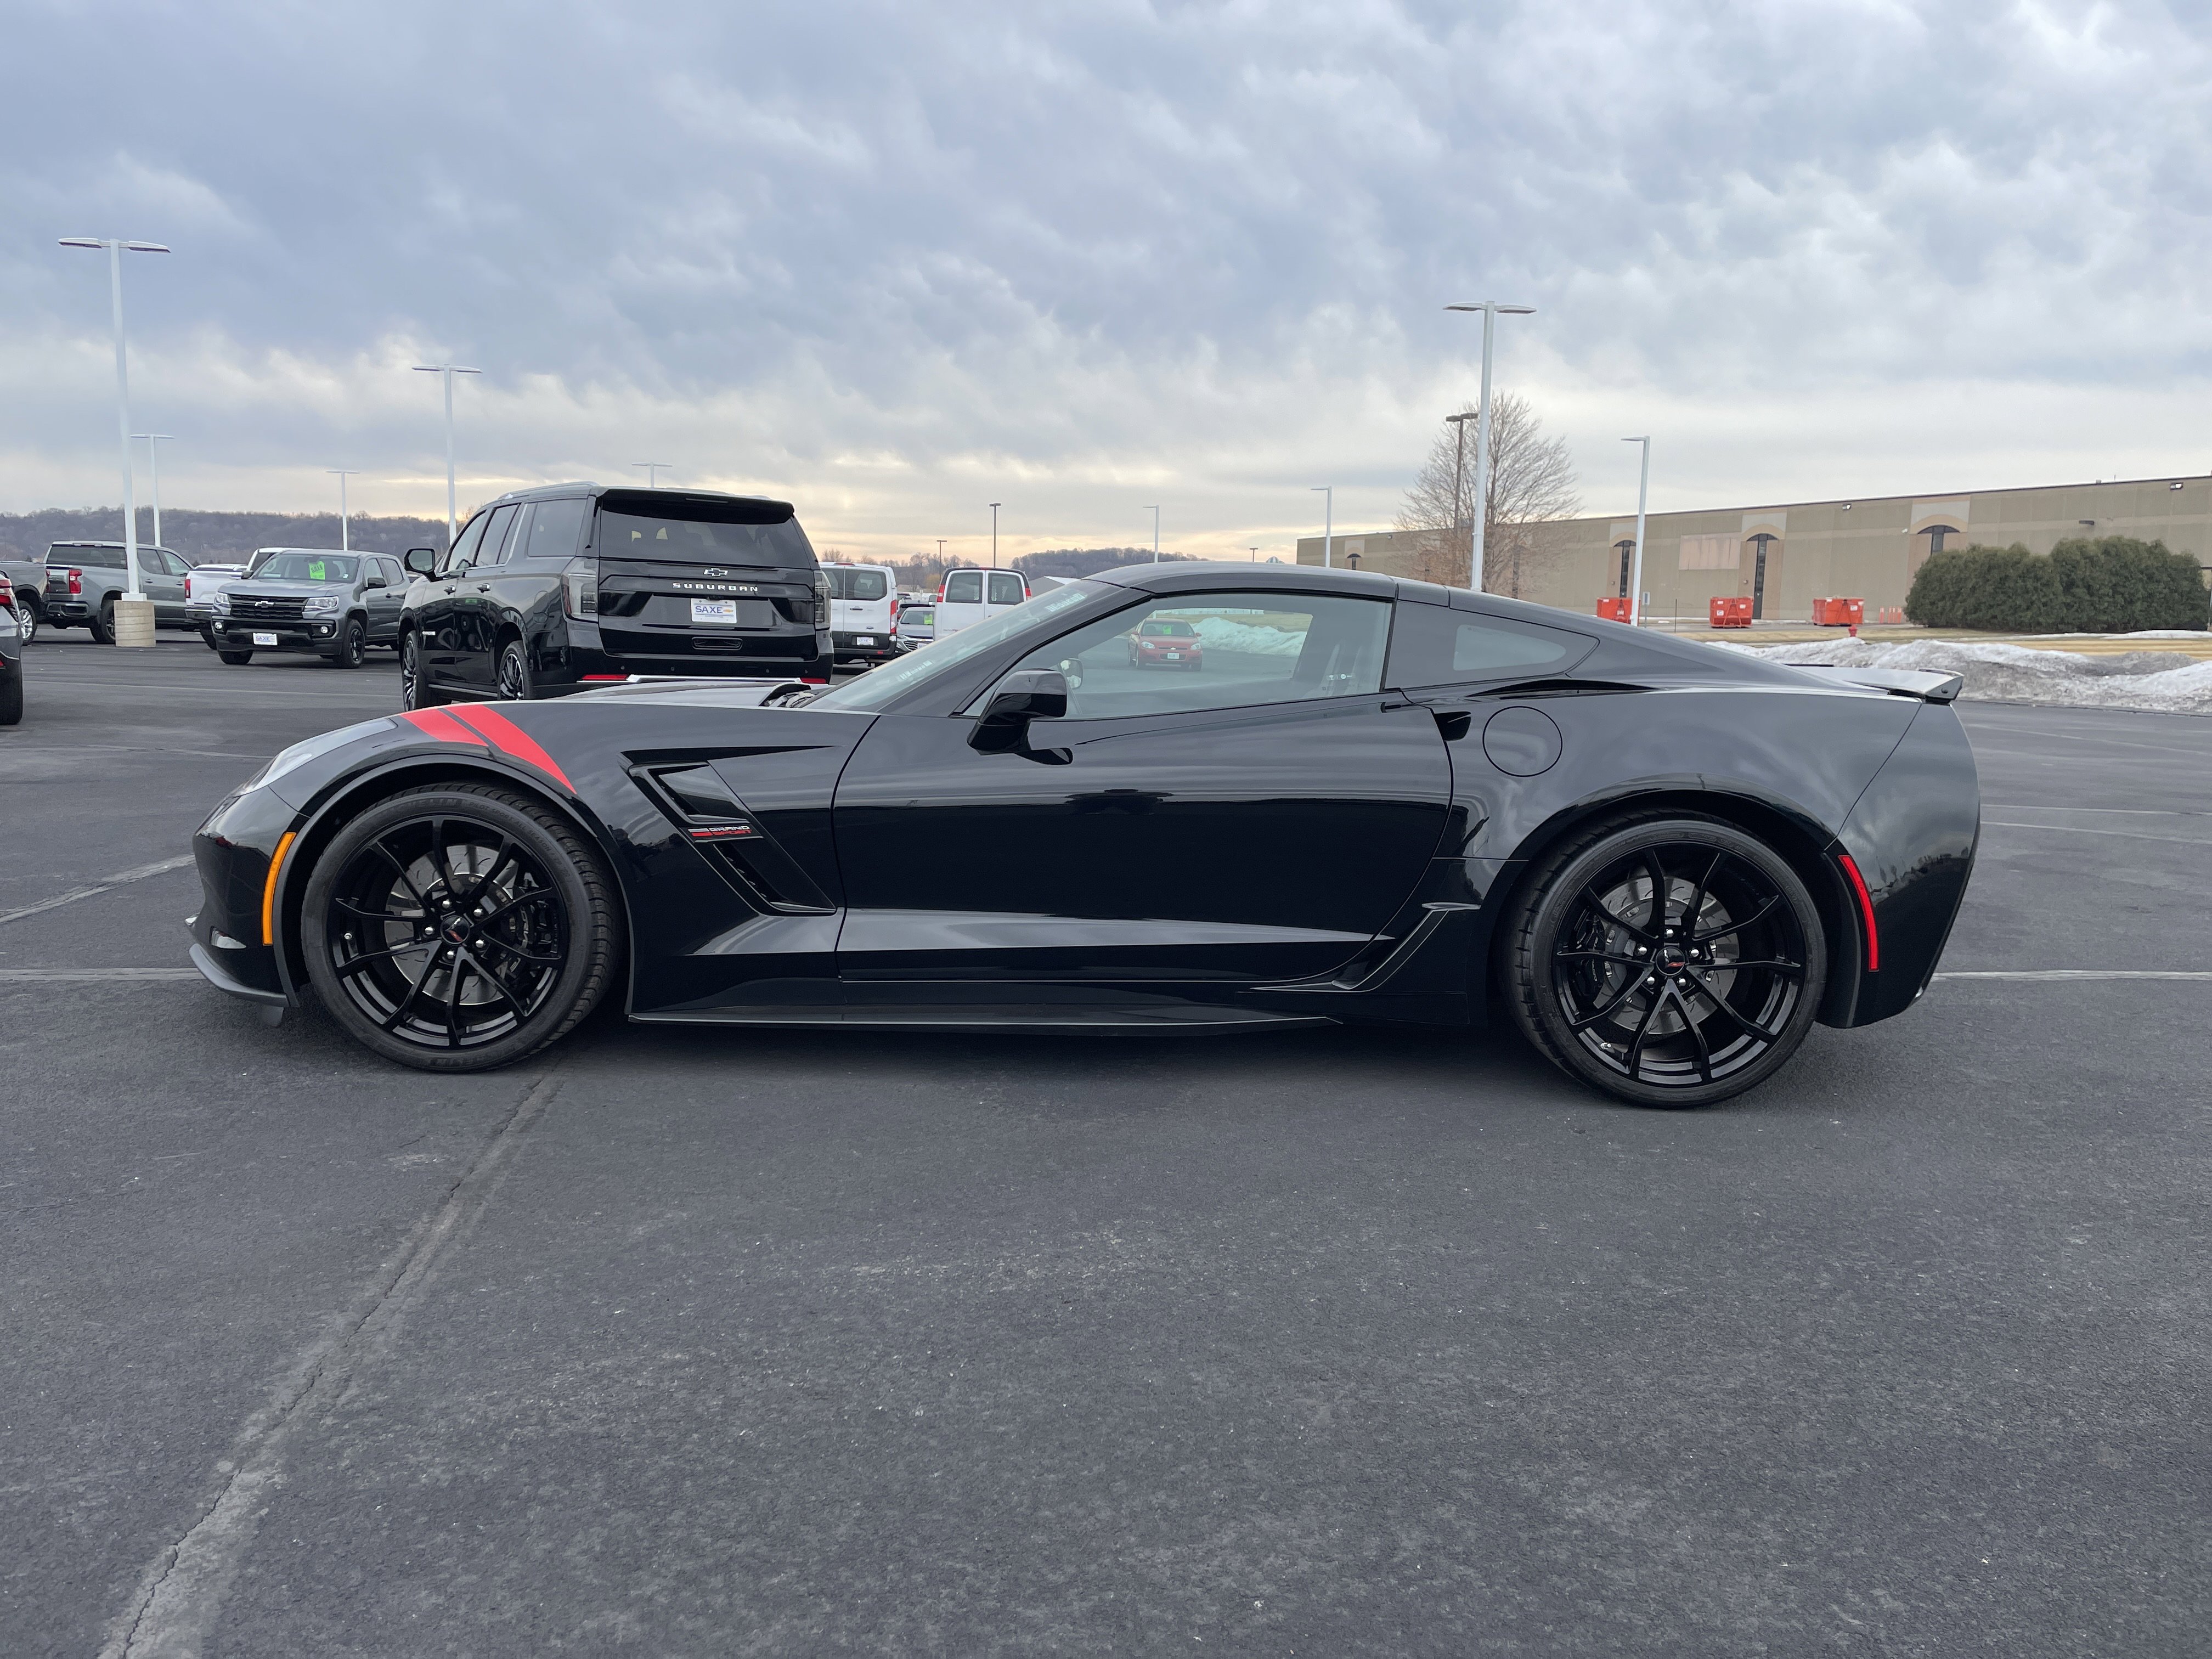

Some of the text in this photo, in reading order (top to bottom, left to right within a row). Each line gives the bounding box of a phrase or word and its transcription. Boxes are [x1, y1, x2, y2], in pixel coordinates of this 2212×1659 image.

[311, 565, 324, 573] SALE
[672, 582, 758, 591] SUBURBAN
[695, 606, 723, 614] SAXE
